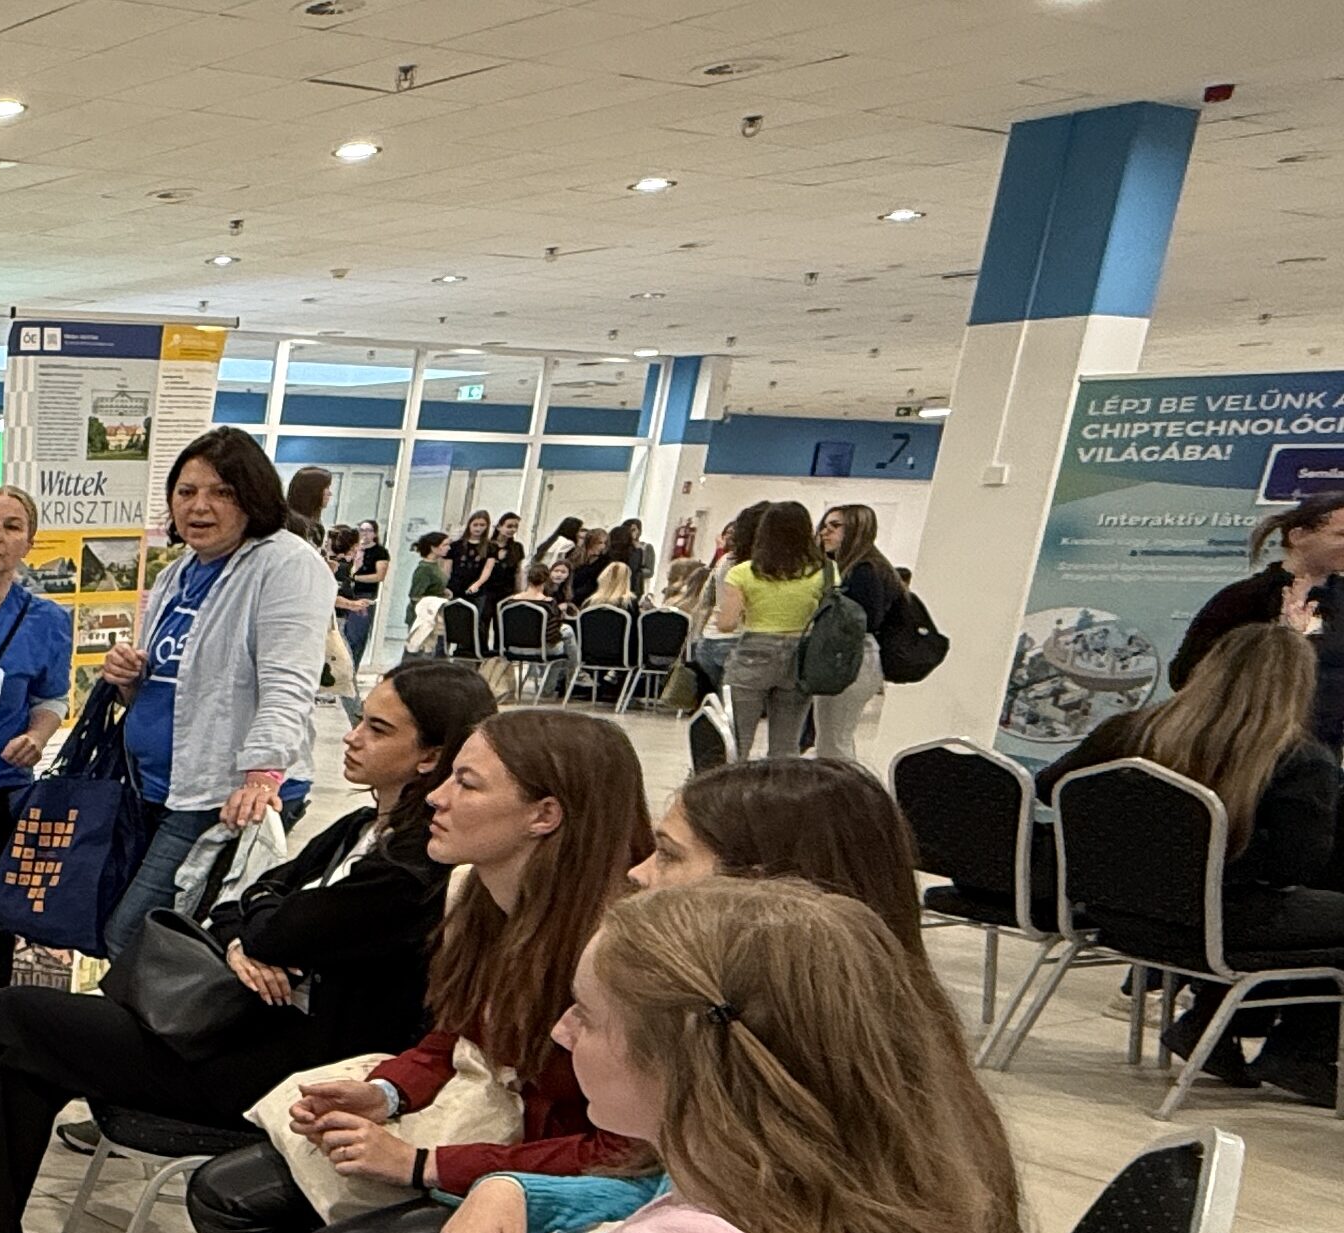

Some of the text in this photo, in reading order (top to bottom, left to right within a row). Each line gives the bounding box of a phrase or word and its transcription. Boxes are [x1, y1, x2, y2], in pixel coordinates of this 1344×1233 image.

[1088, 396, 1152, 416] LÉPJ
[1159, 396, 1197, 413] BE
[1205, 389, 1328, 412] VELÜNK
[1081, 413, 1344, 440] CHIPTECHNOLÓGI
[1077, 441, 1234, 463] VILÁGÁBA!
[40, 470, 108, 496] Wittek
[41, 501, 143, 524] KRISZTINA
[1212, 512, 1257, 527] láto
